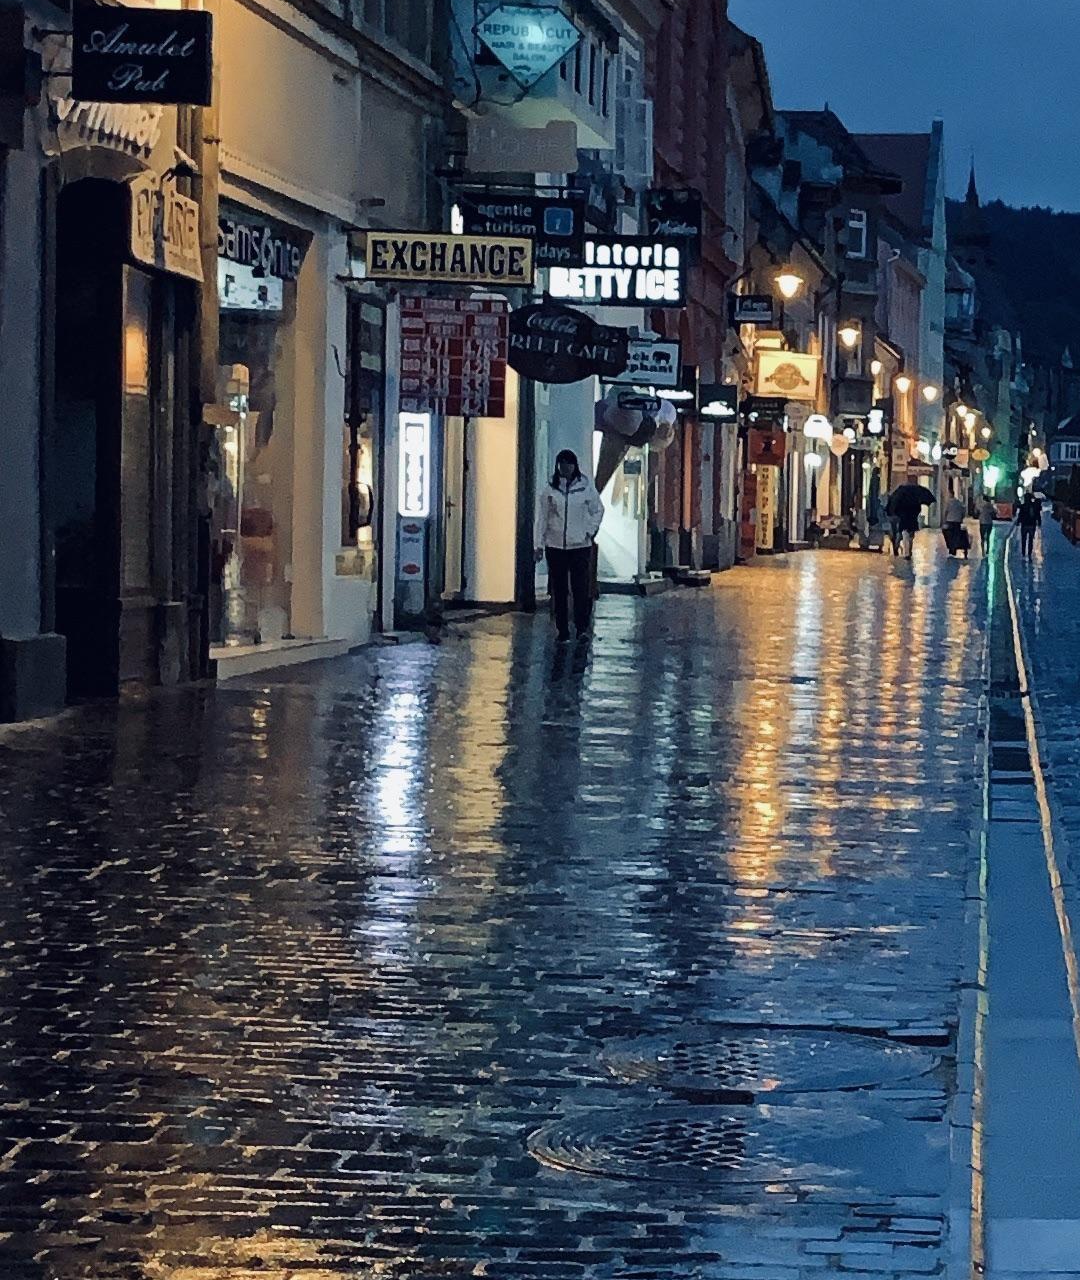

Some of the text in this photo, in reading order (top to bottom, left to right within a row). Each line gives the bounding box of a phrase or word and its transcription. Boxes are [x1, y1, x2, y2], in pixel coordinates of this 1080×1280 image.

[82, 22, 196, 57] Amulet
[483, 23, 572, 40] REPUBCUT
[107, 63, 170, 92] Pub
[485, 221, 537, 234] turism
[370, 239, 527, 277] EXCHANGE
[549, 266, 680, 300] BETTY ICE
